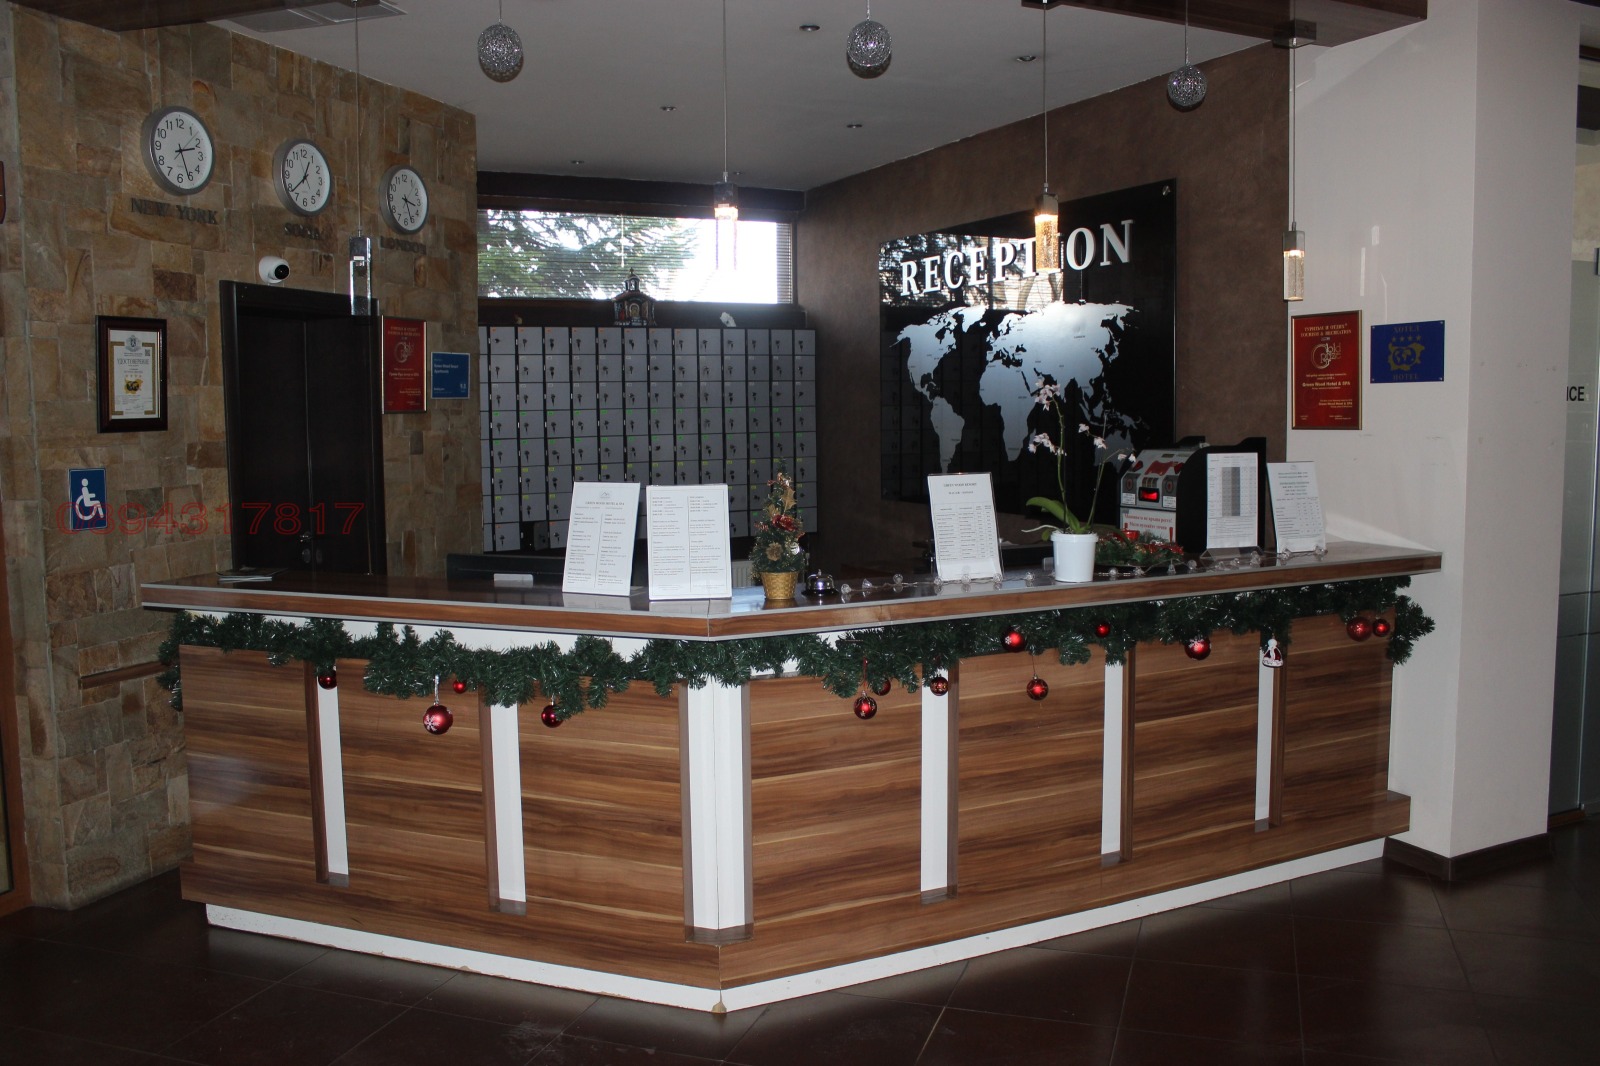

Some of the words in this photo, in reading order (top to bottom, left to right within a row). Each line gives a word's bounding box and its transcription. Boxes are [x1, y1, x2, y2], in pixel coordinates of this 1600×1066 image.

[166, 120, 172, 130] 11
[176, 118, 184, 129] 12
[157, 128, 166, 138] 10
[155, 140, 162, 150] 9
[195, 138, 201, 148] 2
[198, 151, 204, 161] 3
[292, 151, 299, 160] 11
[300, 149, 308, 158] 12
[158, 155, 165, 165] 8
[286, 159, 294, 168] 10
[167, 166, 173, 176] 7
[195, 165, 200, 174] 4
[285, 170, 290, 179] 9
[316, 166, 320, 174] 2
[177, 173, 184, 183] 6
[318, 177, 322, 186] 3
[295, 192, 300, 201] 7
[311, 195, 316, 204] 5
[303, 198, 307, 207] 6
[131, 197, 170, 217] NEW
[176, 204, 218, 225] YORK
[380, 235, 427, 255] LONDON
[900, 219, 1135, 297] RECEPTON
